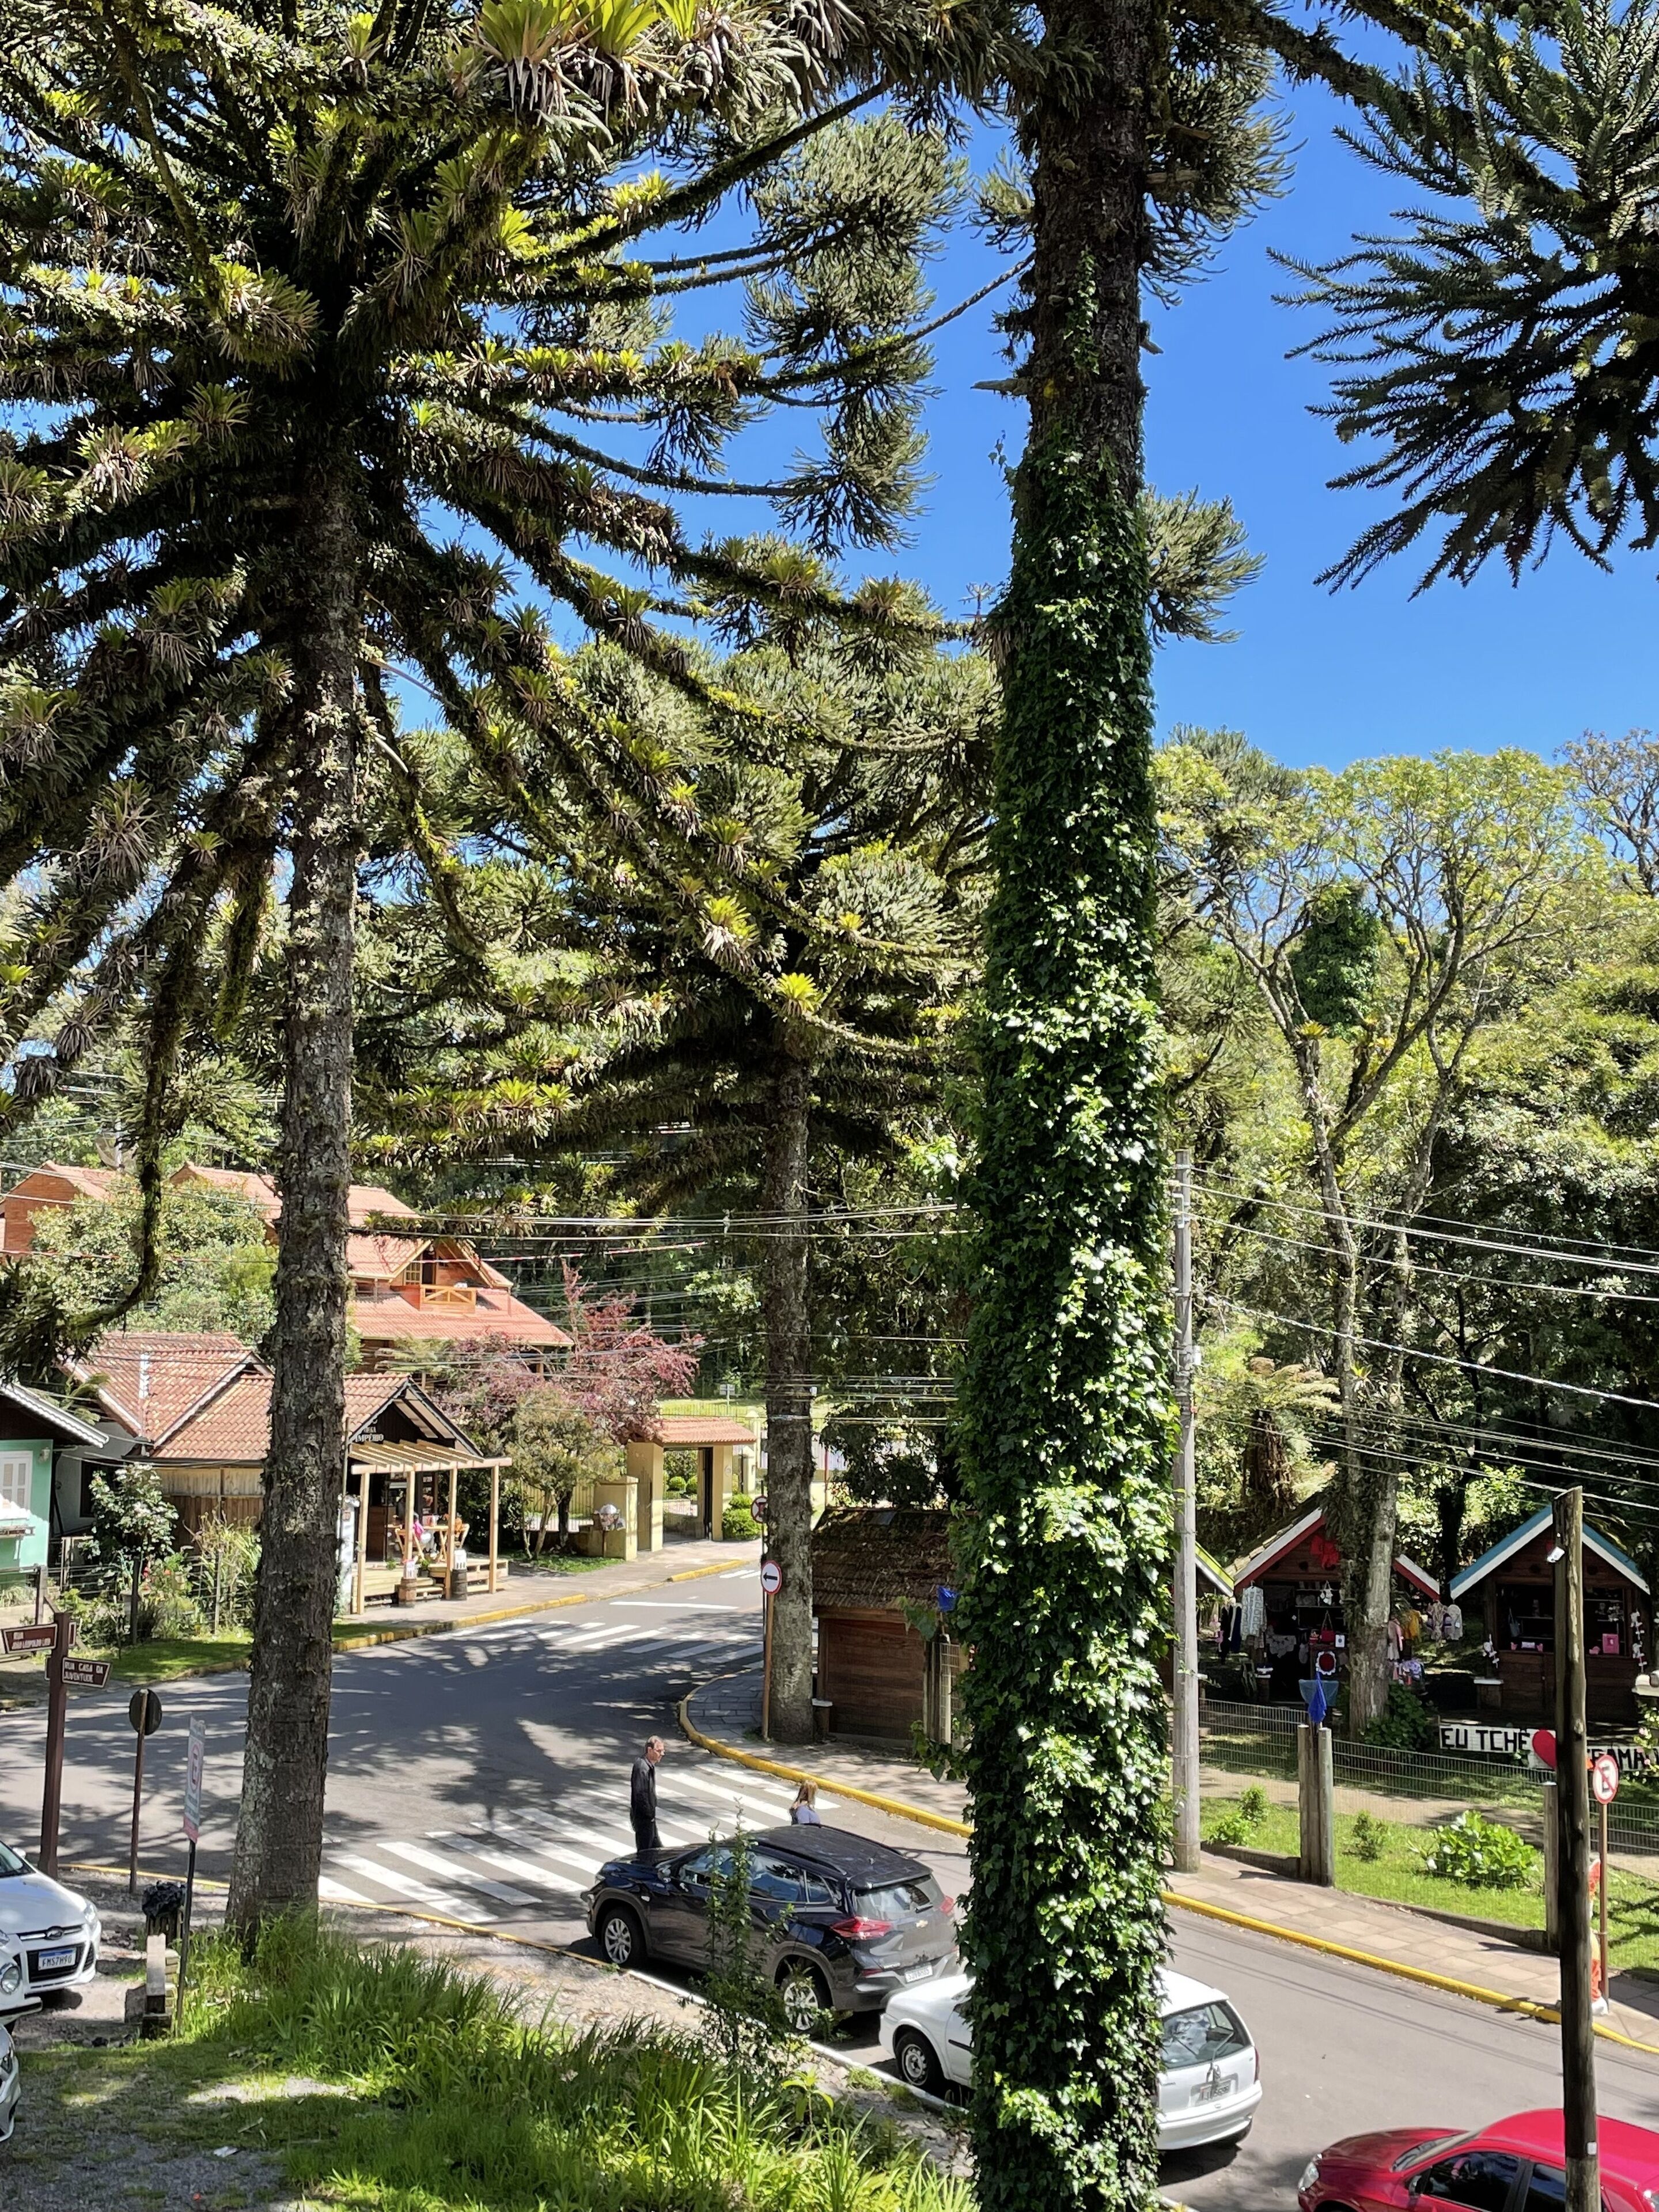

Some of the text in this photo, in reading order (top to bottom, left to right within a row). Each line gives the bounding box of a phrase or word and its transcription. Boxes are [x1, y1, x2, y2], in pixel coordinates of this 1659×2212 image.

[64, 1661, 103, 1674] RUA CASA DA
[63, 1671, 94, 1683] JUVENTUDE
[1441, 1728, 1468, 1749] EU
[1475, 1728, 1531, 1752] TCHÊ
